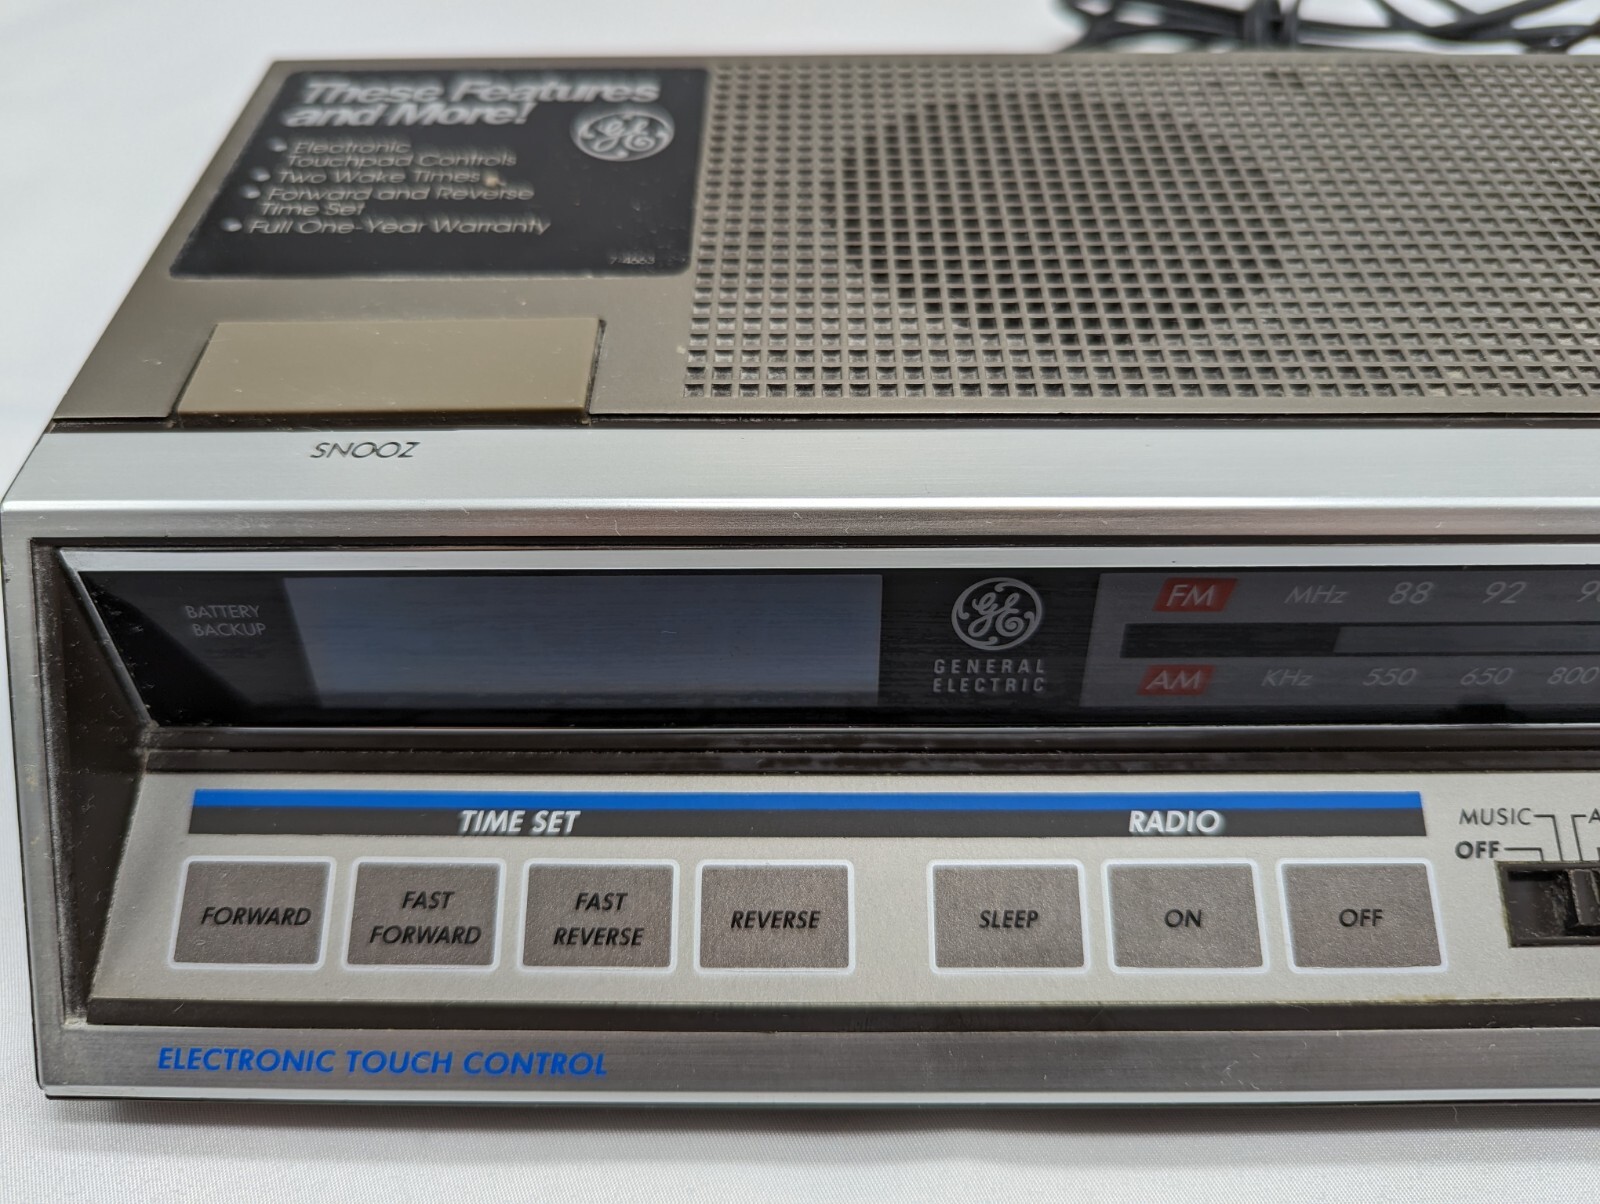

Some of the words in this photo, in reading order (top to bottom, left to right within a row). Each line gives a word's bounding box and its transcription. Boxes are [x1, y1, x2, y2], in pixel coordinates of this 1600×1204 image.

[303, 77, 446, 104] These
[452, 77, 660, 103] Features
[282, 103, 389, 127] and
[388, 102, 538, 127] More!
[293, 138, 412, 154] Electronic
[287, 153, 413, 168] Touchpad
[418, 152, 517, 168] Controls
[278, 169, 327, 184] Two
[332, 169, 406, 184] Wake
[411, 168, 481, 183] Times
[267, 186, 373, 201] Forward
[374, 186, 431, 200] and
[434, 185, 535, 200] Reverse
[260, 202, 320, 216] Time
[324, 201, 366, 216] Set
[249, 218, 293, 234] Full
[296, 217, 427, 234] One-Year
[431, 217, 551, 235] Warranty
[310, 441, 421, 458] SNOOZ
[1166, 584, 1216, 607] FM
[1284, 585, 1347, 604] MHz
[1388, 581, 1435, 605] 88
[1482, 581, 1527, 604] 92
[184, 604, 260, 619] BATTERY
[192, 622, 266, 637] BACKUP
[933, 659, 1045, 674] GENERAL
[932, 677, 1045, 693] ELECTRIC
[1145, 670, 1202, 690] AM
[1261, 669, 1313, 686] KHz
[1362, 668, 1418, 686] 550
[1460, 667, 1514, 685] 650
[1547, 667, 1600, 685] 800
[459, 810, 523, 832] TIME
[530, 810, 581, 833] SET
[1128, 810, 1222, 833] RADIO
[1459, 808, 1531, 826] MUSIC
[1455, 840, 1500, 859] OFF
[402, 890, 454, 909] FAST
[574, 892, 628, 911] FAST
[201, 907, 311, 926] FORWARD
[731, 910, 821, 929] REVERSE
[979, 910, 1039, 929] SLEEP
[1164, 909, 1202, 928] ON
[1339, 908, 1383, 928] OFF
[370, 925, 482, 945] FORWARD
[553, 927, 645, 947] REVERSE
[158, 1047, 336, 1072] ELECTRONIC
[347, 1050, 453, 1074] TOUCH
[463, 1052, 608, 1077] CONTROL
